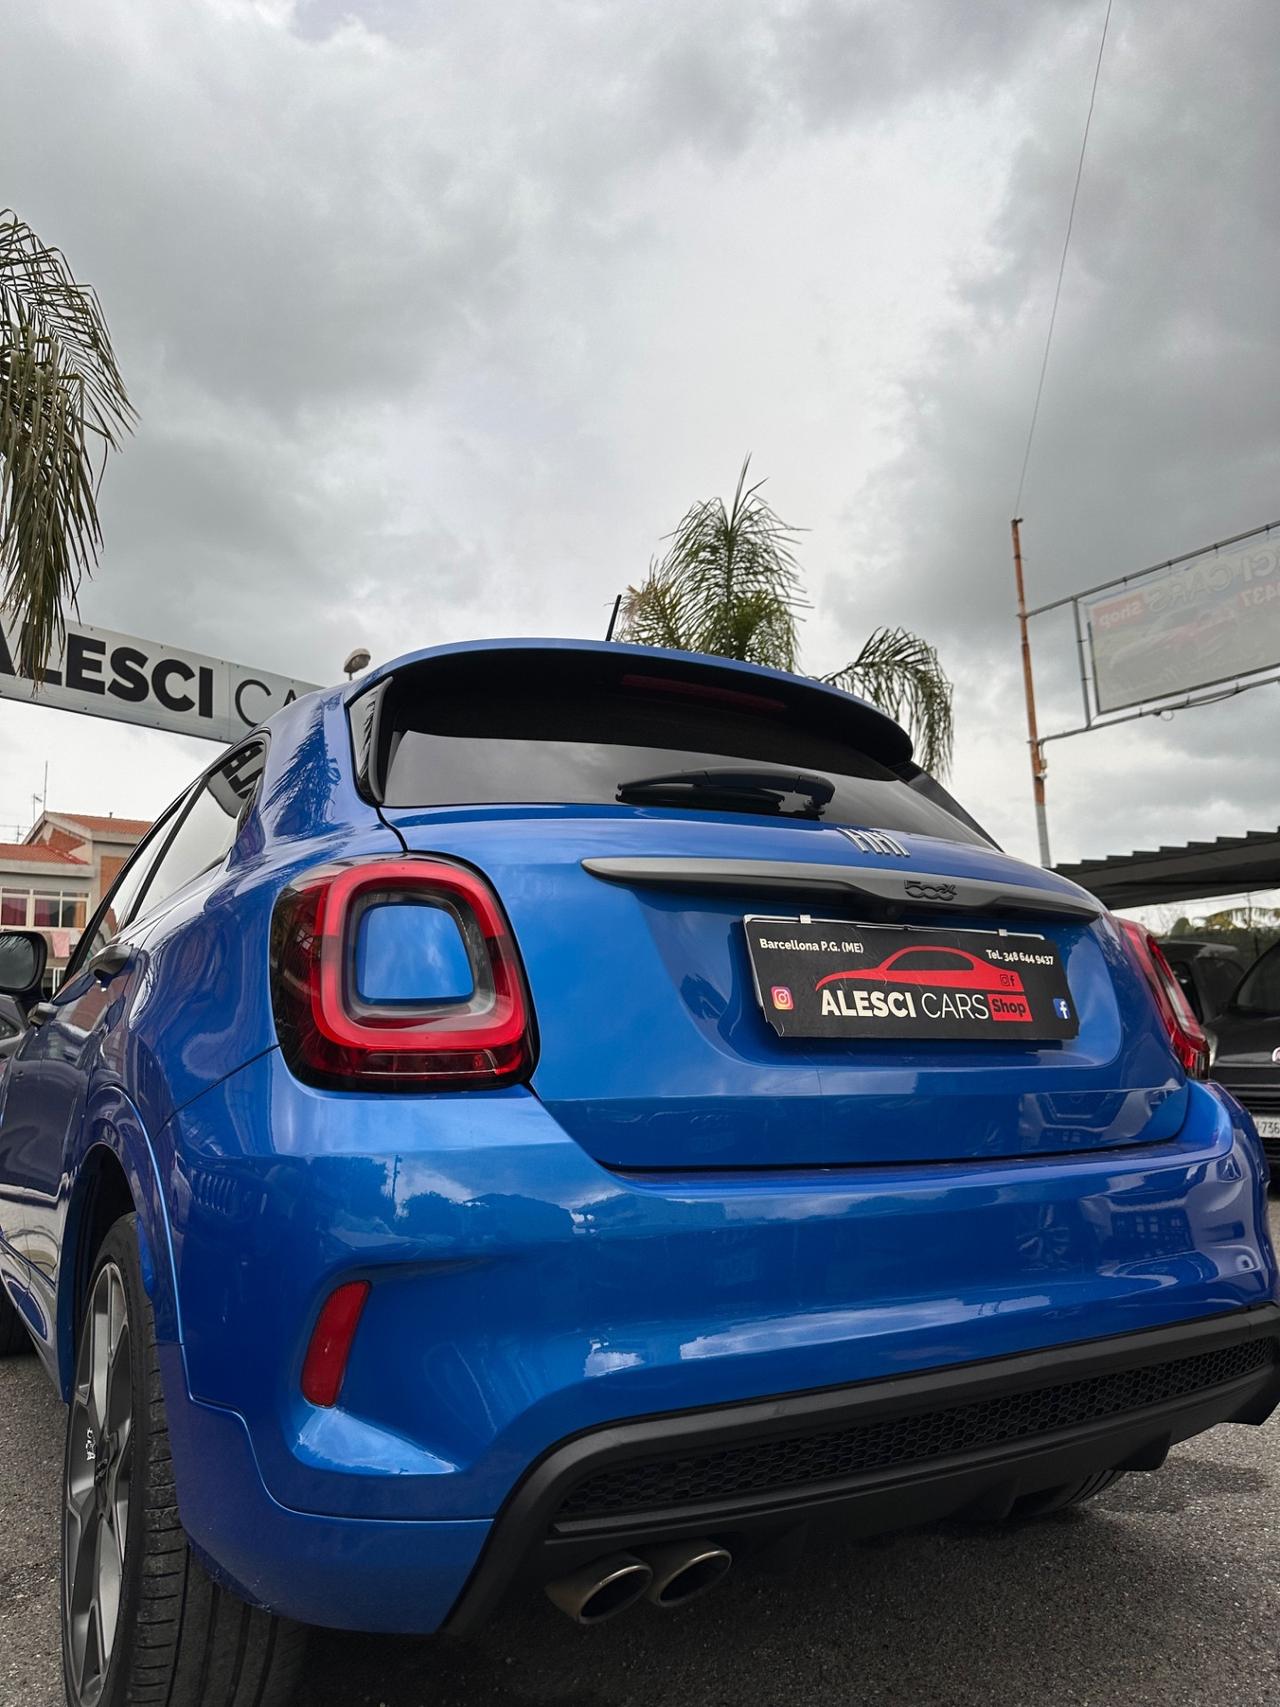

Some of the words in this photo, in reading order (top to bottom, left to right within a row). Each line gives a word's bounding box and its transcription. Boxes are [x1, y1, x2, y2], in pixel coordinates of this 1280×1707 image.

[759, 938, 820, 951] Barcellona
[820, 941, 841, 952] P.G.
[841, 942, 864, 953] (ME)
[1003, 951, 1019, 962] 348
[1019, 952, 1035, 964] 644
[1035, 955, 1054, 965] 9437
[821, 989, 917, 1018] ALESCI
[921, 992, 989, 1020] CARS
[993, 998, 1026, 1017] Shop
